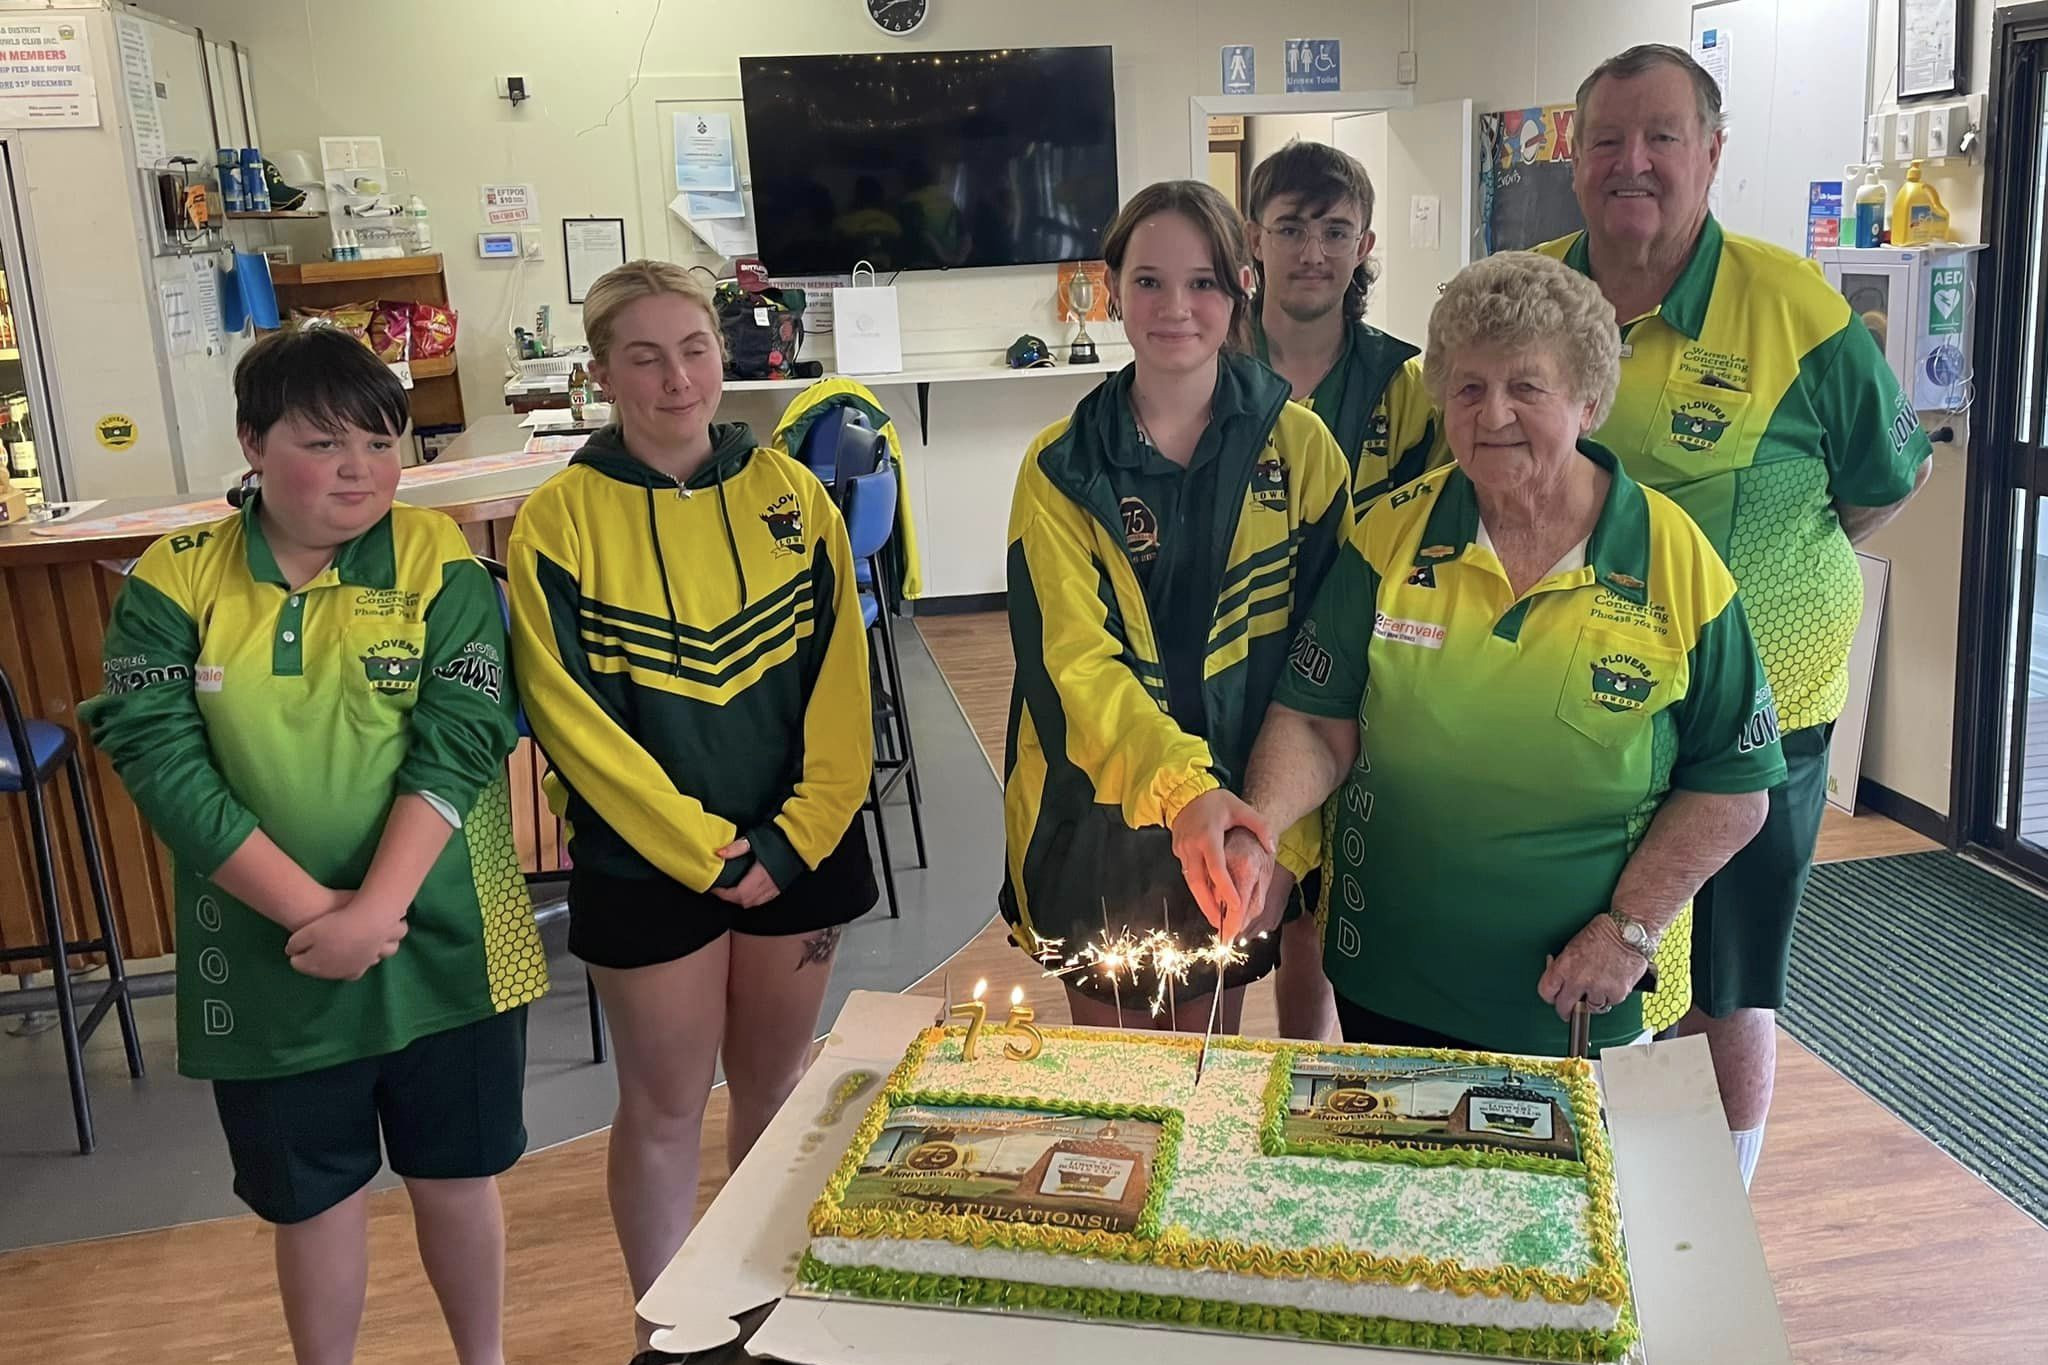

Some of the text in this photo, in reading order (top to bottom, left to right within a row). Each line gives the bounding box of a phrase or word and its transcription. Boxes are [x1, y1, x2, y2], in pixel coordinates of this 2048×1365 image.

[883, 18, 889, 27] 7
[895, 22, 901, 31] 6
[907, 18, 913, 28] 5
[8, 26, 40, 34] DISTRICT
[10, 49, 67, 61] MEMBERS
[32, 79, 73, 87] DECEMBER
[496, 188, 525, 196] EFTPOS
[807, 280, 845, 289] MEMBERS
[1933, 270, 1963, 287] AED
[1692, 346, 1746, 363] Warren Lee
[1683, 351, 1749, 373] Concreting
[1680, 400, 1727, 419] PLOVERS
[1672, 434, 1714, 448] LOWOOD
[1122, 509, 1145, 534] 75
[1594, 594, 1669, 624] Concreting
[1650, 601, 1666, 612] Lee
[1382, 618, 1446, 640] Fernvale
[1634, 618, 1652, 629] 762
[367, 639, 420, 657] PLOVERS
[1600, 653, 1652, 678] PLOVERS
[1594, 692, 1641, 709] LOWOOD
[949, 1000, 1043, 1062] 75
[1337, 1093, 1370, 1106] 75
[915, 1148, 952, 1162] 75
[859, 1198, 1120, 1231] CONGRATULATIONS!!
